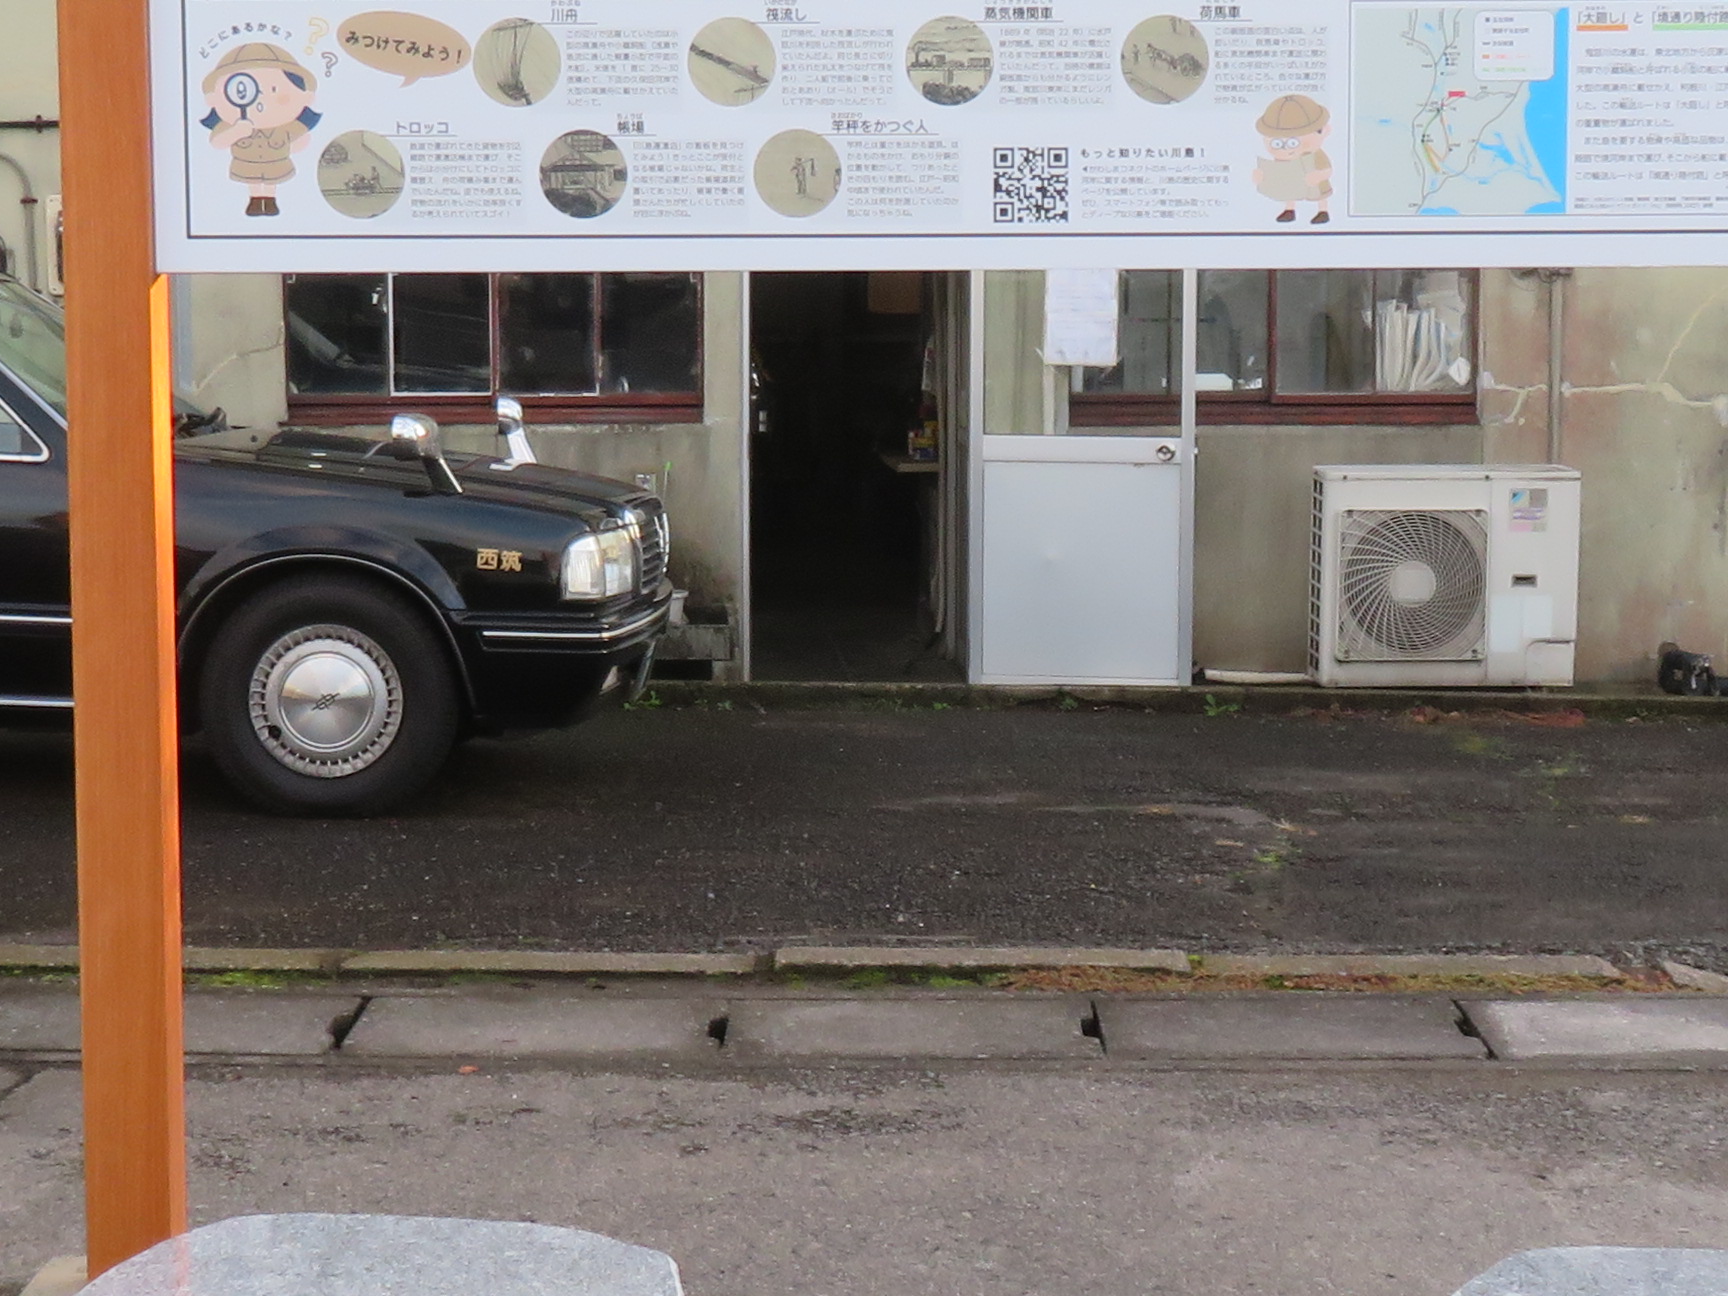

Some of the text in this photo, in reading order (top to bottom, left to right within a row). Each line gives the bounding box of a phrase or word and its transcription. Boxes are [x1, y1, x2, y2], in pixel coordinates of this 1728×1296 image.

[983, 5, 1054, 20] 蒸気機関車
[1199, 4, 1241, 20] 荷馬車
[344, 30, 462, 64] みつけてみよう！
[396, 121, 450, 134] トロッコ
